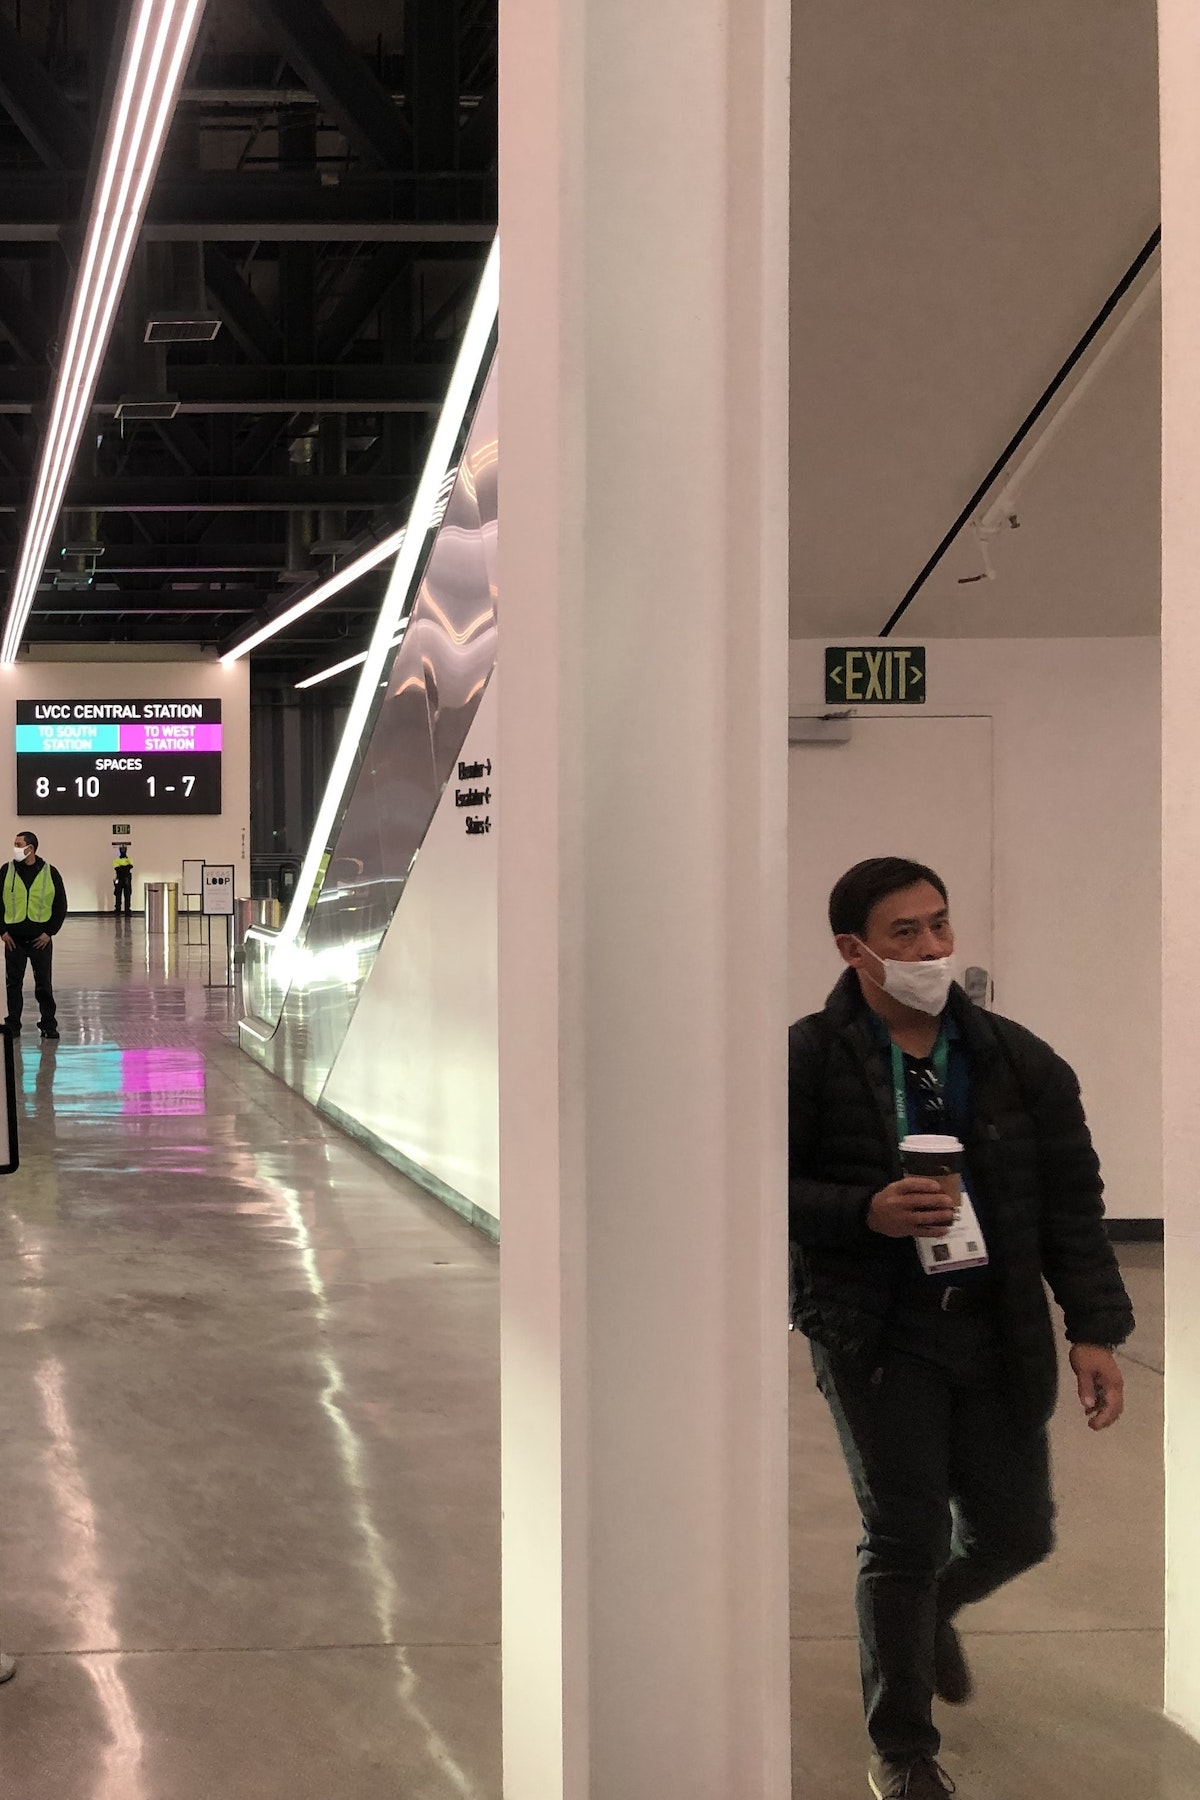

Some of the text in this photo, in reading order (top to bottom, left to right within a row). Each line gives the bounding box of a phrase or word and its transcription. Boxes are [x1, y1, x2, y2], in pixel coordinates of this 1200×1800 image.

[845, 651, 912, 700] EXIT
[35, 703, 203, 719] LVCC CENTRAL STATION
[38, 725, 97, 737] TO SOUTH
[144, 725, 196, 737] TO WEST
[42, 738, 93, 750] STATION
[145, 738, 195, 750] STATION
[95, 758, 143, 771] SPACES
[35, 776, 50, 798] 8
[74, 776, 100, 798] 10
[146, 775, 156, 798] 1
[182, 775, 196, 798] 7
[206, 877, 231, 886] LOOP
